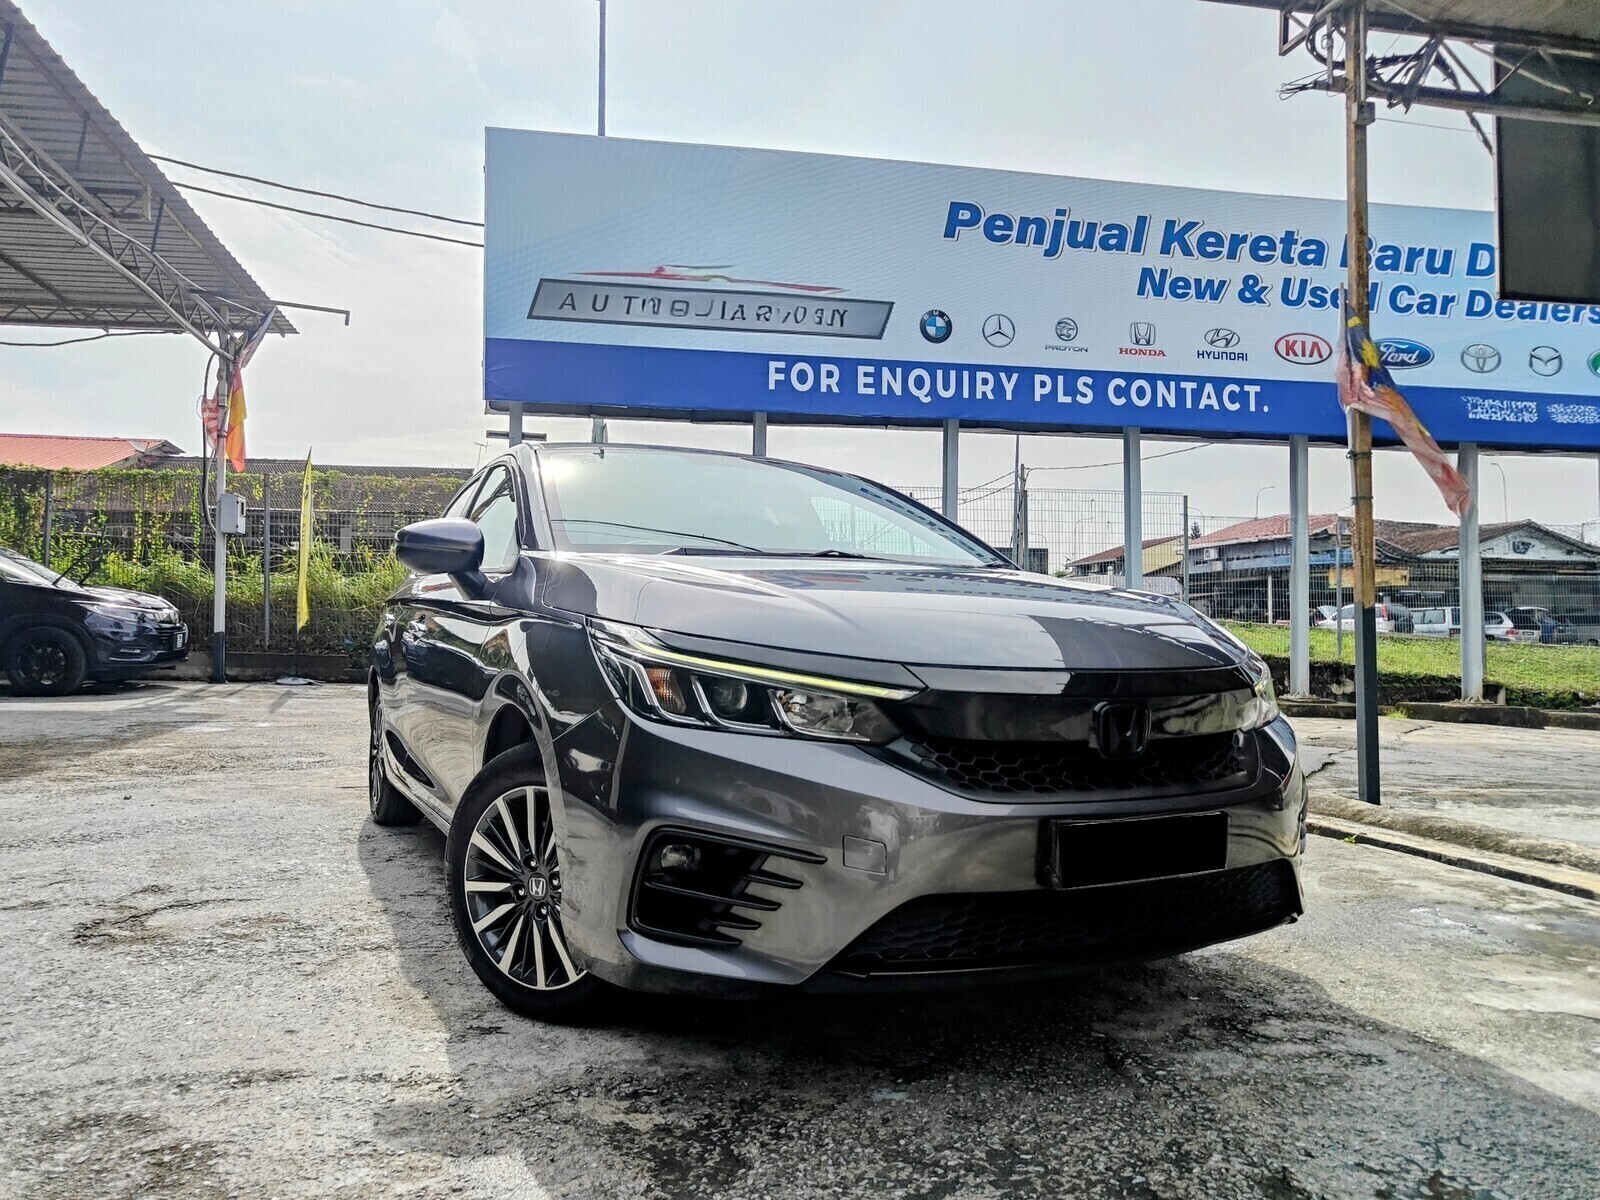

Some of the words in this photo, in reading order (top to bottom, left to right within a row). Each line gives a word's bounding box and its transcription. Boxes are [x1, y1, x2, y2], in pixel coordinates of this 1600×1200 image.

[943, 201, 1150, 258] Penjual
[1159, 219, 1327, 268] Kereta
[1137, 267, 1227, 301] New
[1237, 274, 1270, 305] &
[1388, 284, 1458, 317] Car
[1044, 344, 1089, 353] PROTON
[1118, 347, 1167, 357] HONDA
[1196, 350, 1248, 362] HYUNDAI
[1284, 339, 1324, 359] KIA
[1380, 342, 1420, 364] Ford
[768, 361, 840, 393] FOR
[857, 366, 1019, 404] ENQUIRY
[1033, 373, 1094, 405] PLS
[1107, 377, 1270, 413] CONTACT.
